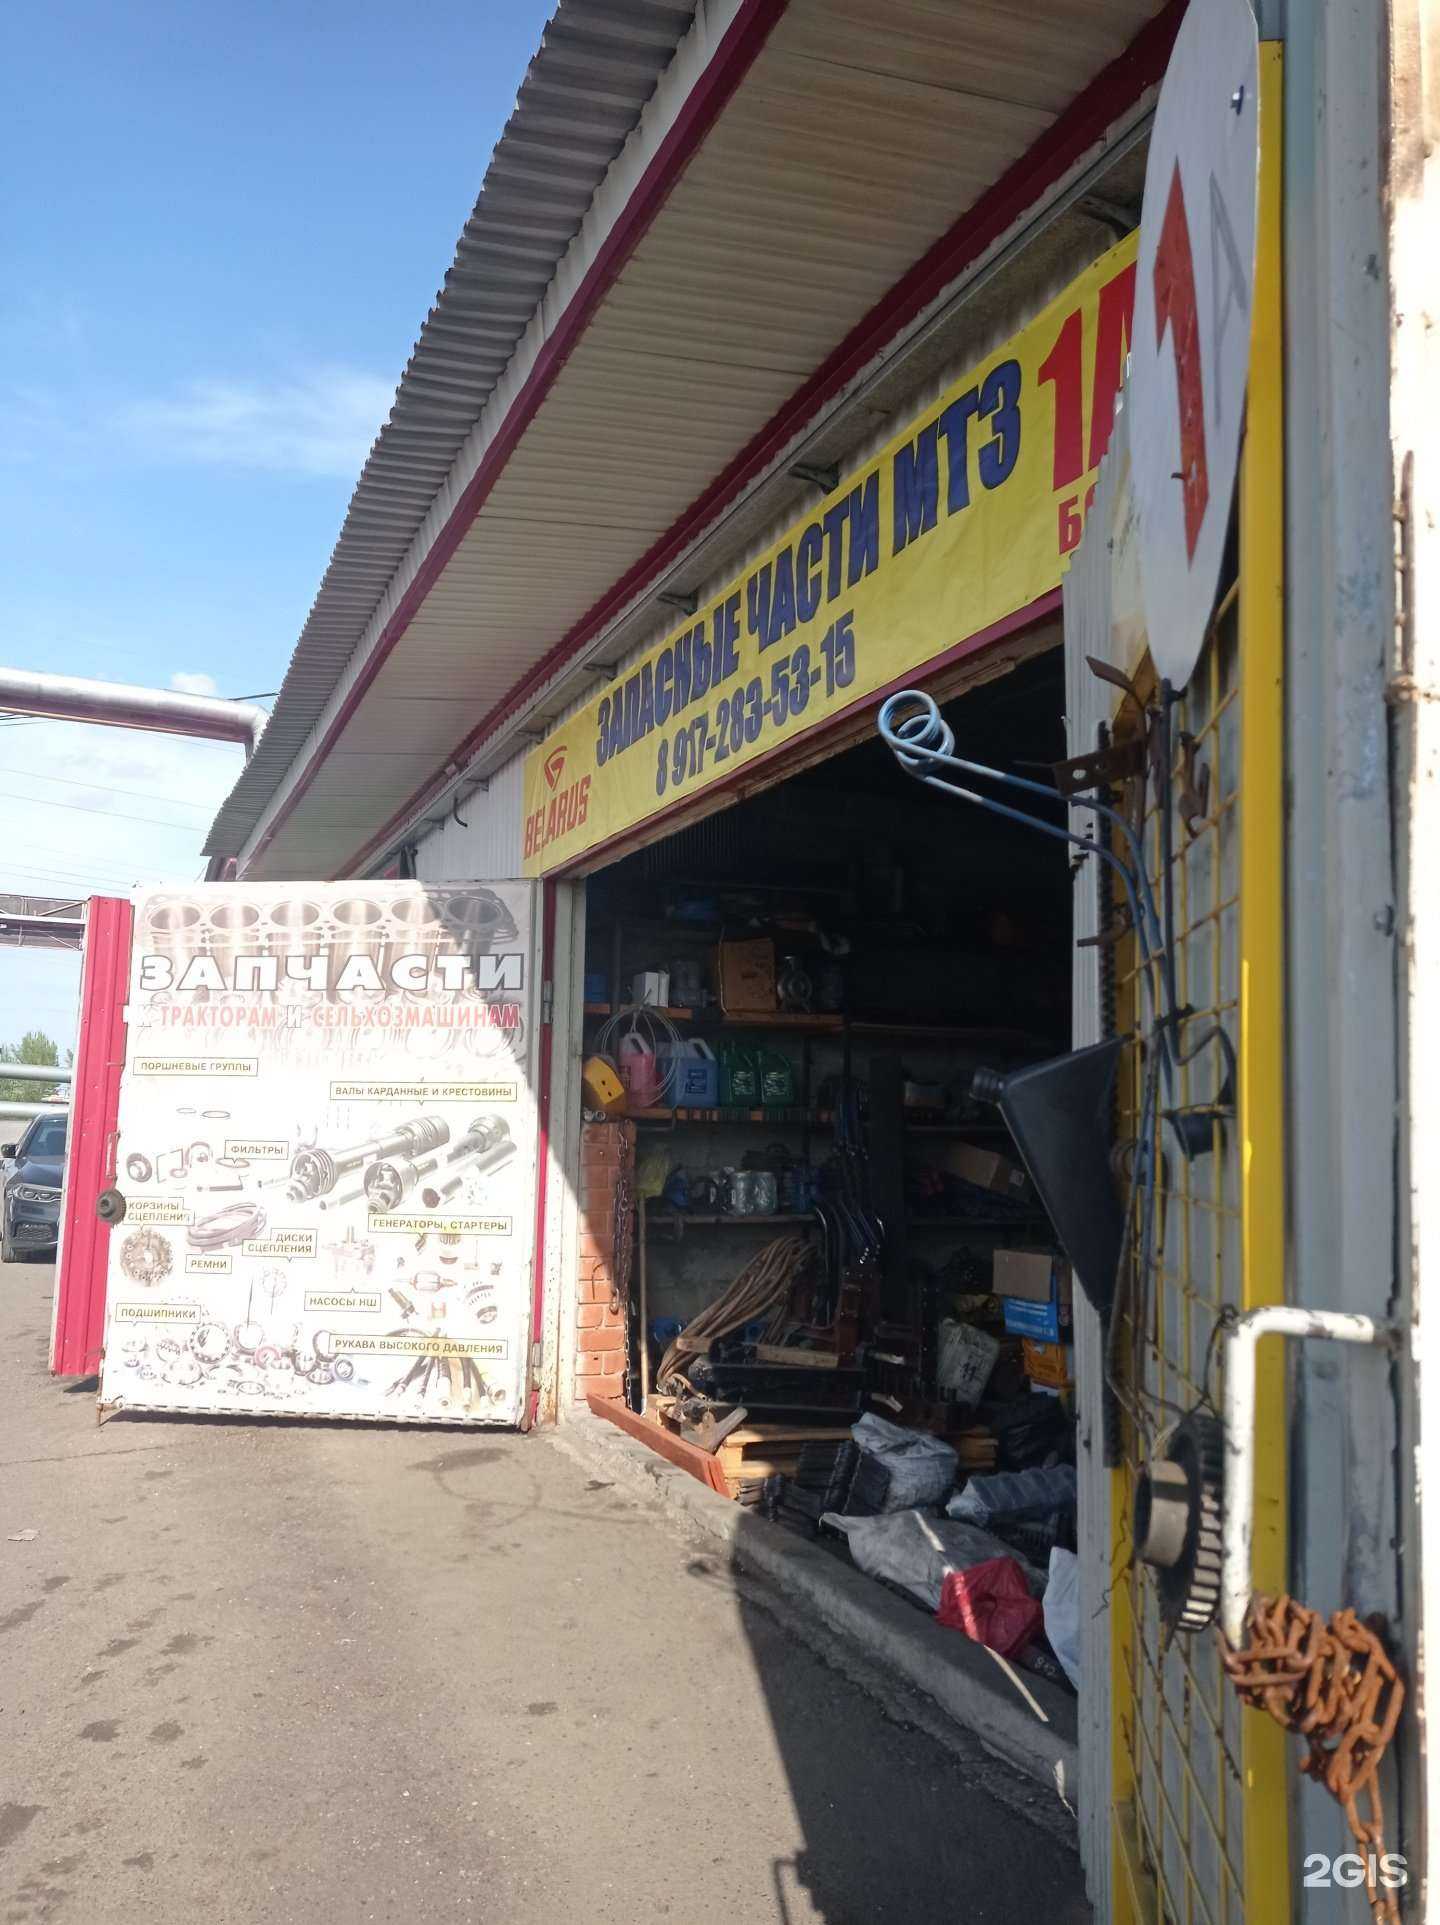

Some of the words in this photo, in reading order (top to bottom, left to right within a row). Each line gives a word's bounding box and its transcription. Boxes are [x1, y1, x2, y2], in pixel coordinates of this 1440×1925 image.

[596, 589, 740, 767] ЗАПАСНЫЕ
[747, 468, 880, 654] ЧАСТИ
[893, 358, 1022, 557] МТЗ
[672, 609, 857, 787] 917-283-53-15
[523, 774, 591, 860] BELARUS
[139, 953, 525, 991] ЗАПЧАСТИ
[161, 1005, 277, 1028] ТРАКТОРАМ
[286, 1004, 304, 1029] И
[312, 1004, 521, 1029] СЕЛЬХОЗМАШИНАМ
[141, 1062, 207, 1072] ПОРШНЕВЫЕ
[210, 1062, 251, 1072] ГРУППЫ
[335, 1086, 364, 1096] ВАЛЫ
[367, 1087, 428, 1097] КАРДАННЫЕ
[432, 1087, 439, 1096] И
[442, 1087, 512, 1097] КРЕСТОВИНЫ
[230, 1143, 284, 1155] ФИЛЬТРЫ
[128, 1201, 180, 1211] КОРЗИНЫ
[373, 1219, 447, 1230] ГЕНЕРАТОРЫ,
[450, 1220, 507, 1230] СТАРТЕРЫ
[275, 1233, 313, 1244] ДИСКИ
[247, 1243, 312, 1254] СЦЕПЛЕНИЯ
[190, 1260, 228, 1269] РЕМНИ
[308, 1296, 356, 1307] НАСОСЫ
[358, 1297, 378, 1308] НШ
[120, 1307, 197, 1319] ПОДШИПНИКИ
[334, 1339, 376, 1350] РУКАВА
[379, 1340, 440, 1352] ВЫСОКОГО
[442, 1342, 503, 1354] ДАВЛЕНИЯ
